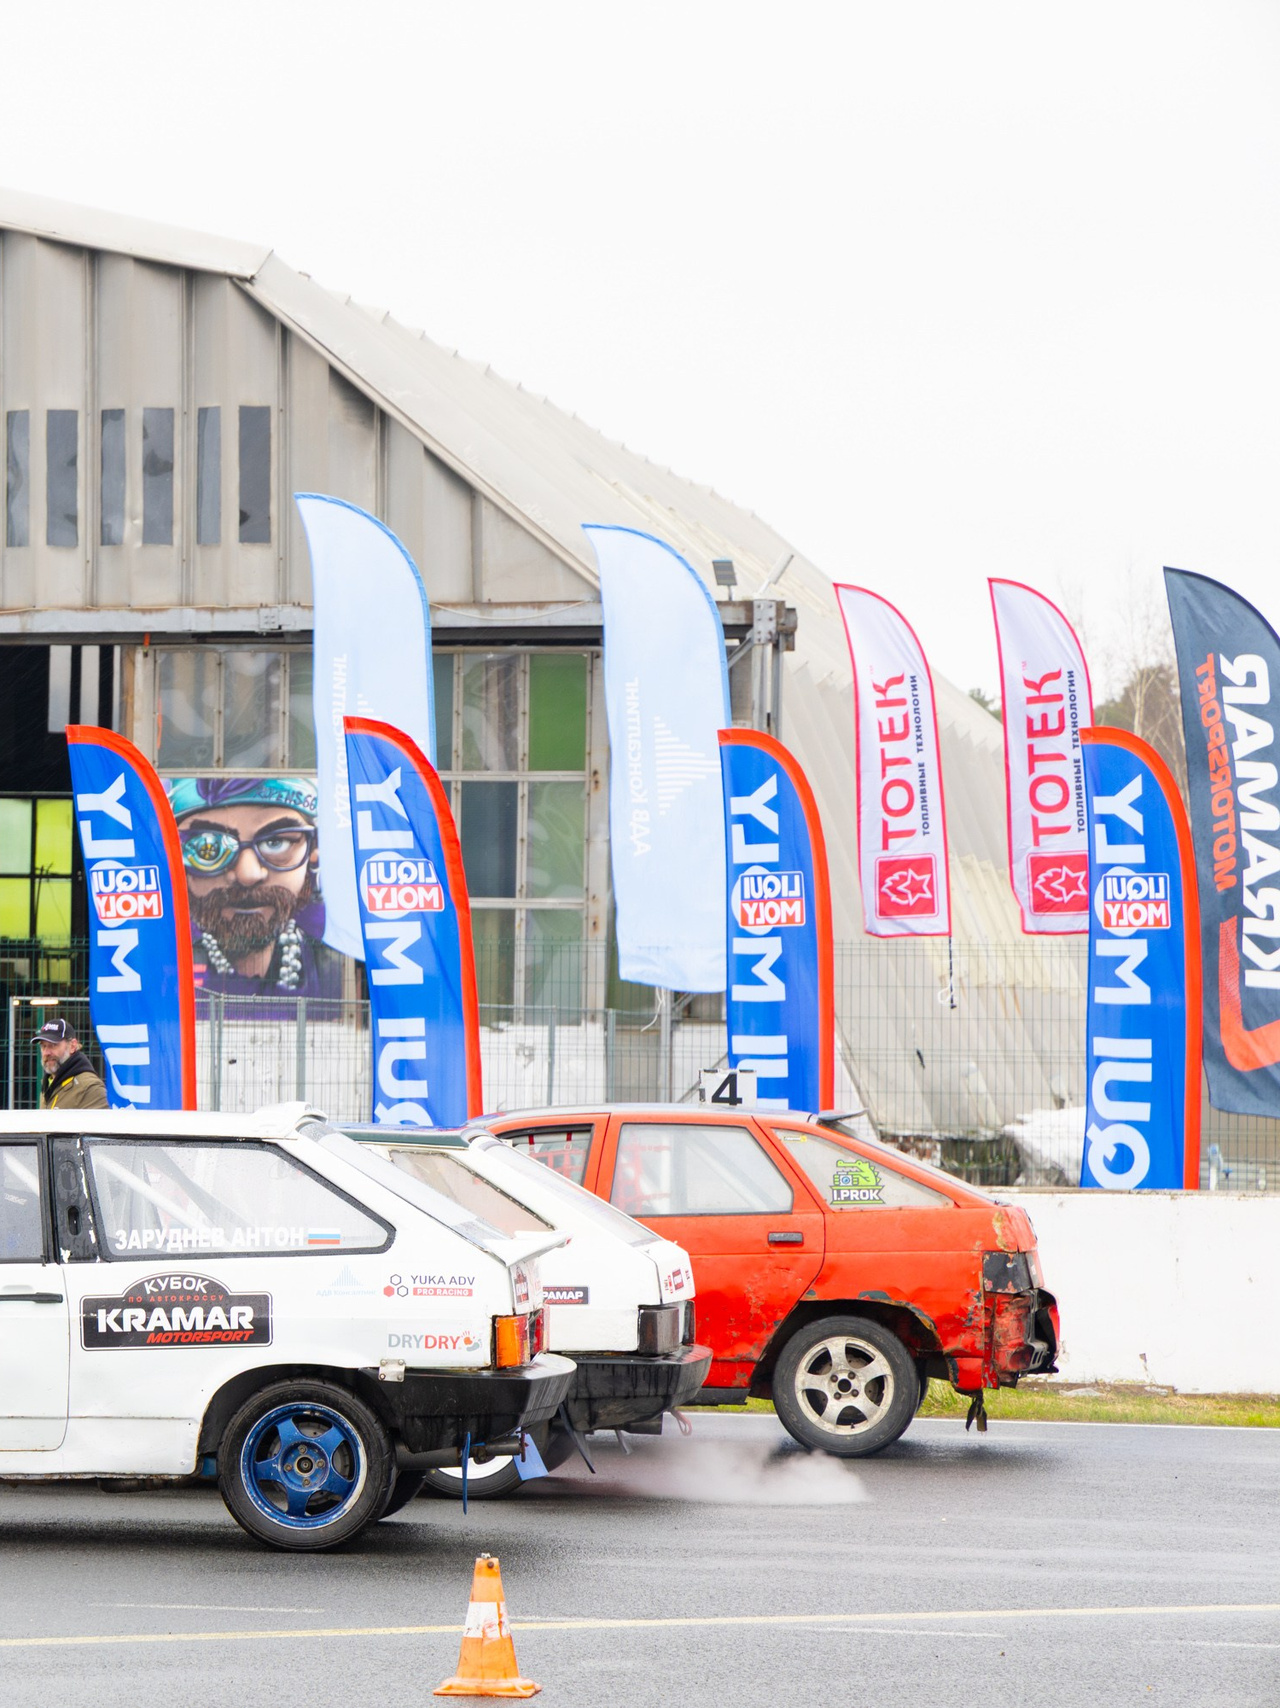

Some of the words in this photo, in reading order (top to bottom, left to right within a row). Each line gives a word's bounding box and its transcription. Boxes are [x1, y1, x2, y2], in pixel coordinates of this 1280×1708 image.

[910, 675, 924, 754] ТЕХНОЛОГИИ
[1067, 670, 1080, 749] ТЕХНОЛОГИИ
[918, 762, 930, 836] ТОПЛИВНЫЕ
[1073, 758, 1086, 833] ТОПЛИВНЫЕ
[711, 1073, 743, 1106] 4
[833, 1189, 880, 1201] I.PROK
[115, 1227, 225, 1252] ЗАРУДНЕВ
[231, 1227, 305, 1248] АНТОН
[144, 1276, 210, 1295] КУБОК
[411, 1275, 446, 1285] YUKA
[449, 1276, 475, 1286] ADV
[149, 1295, 224, 1303] АВТОКРОССУ
[542, 1291, 584, 1300] РАМАР
[98, 1306, 254, 1333] KRAMAR
[146, 1330, 254, 1344] MOTORSPORT
[388, 1334, 460, 1349] DRYDRY
